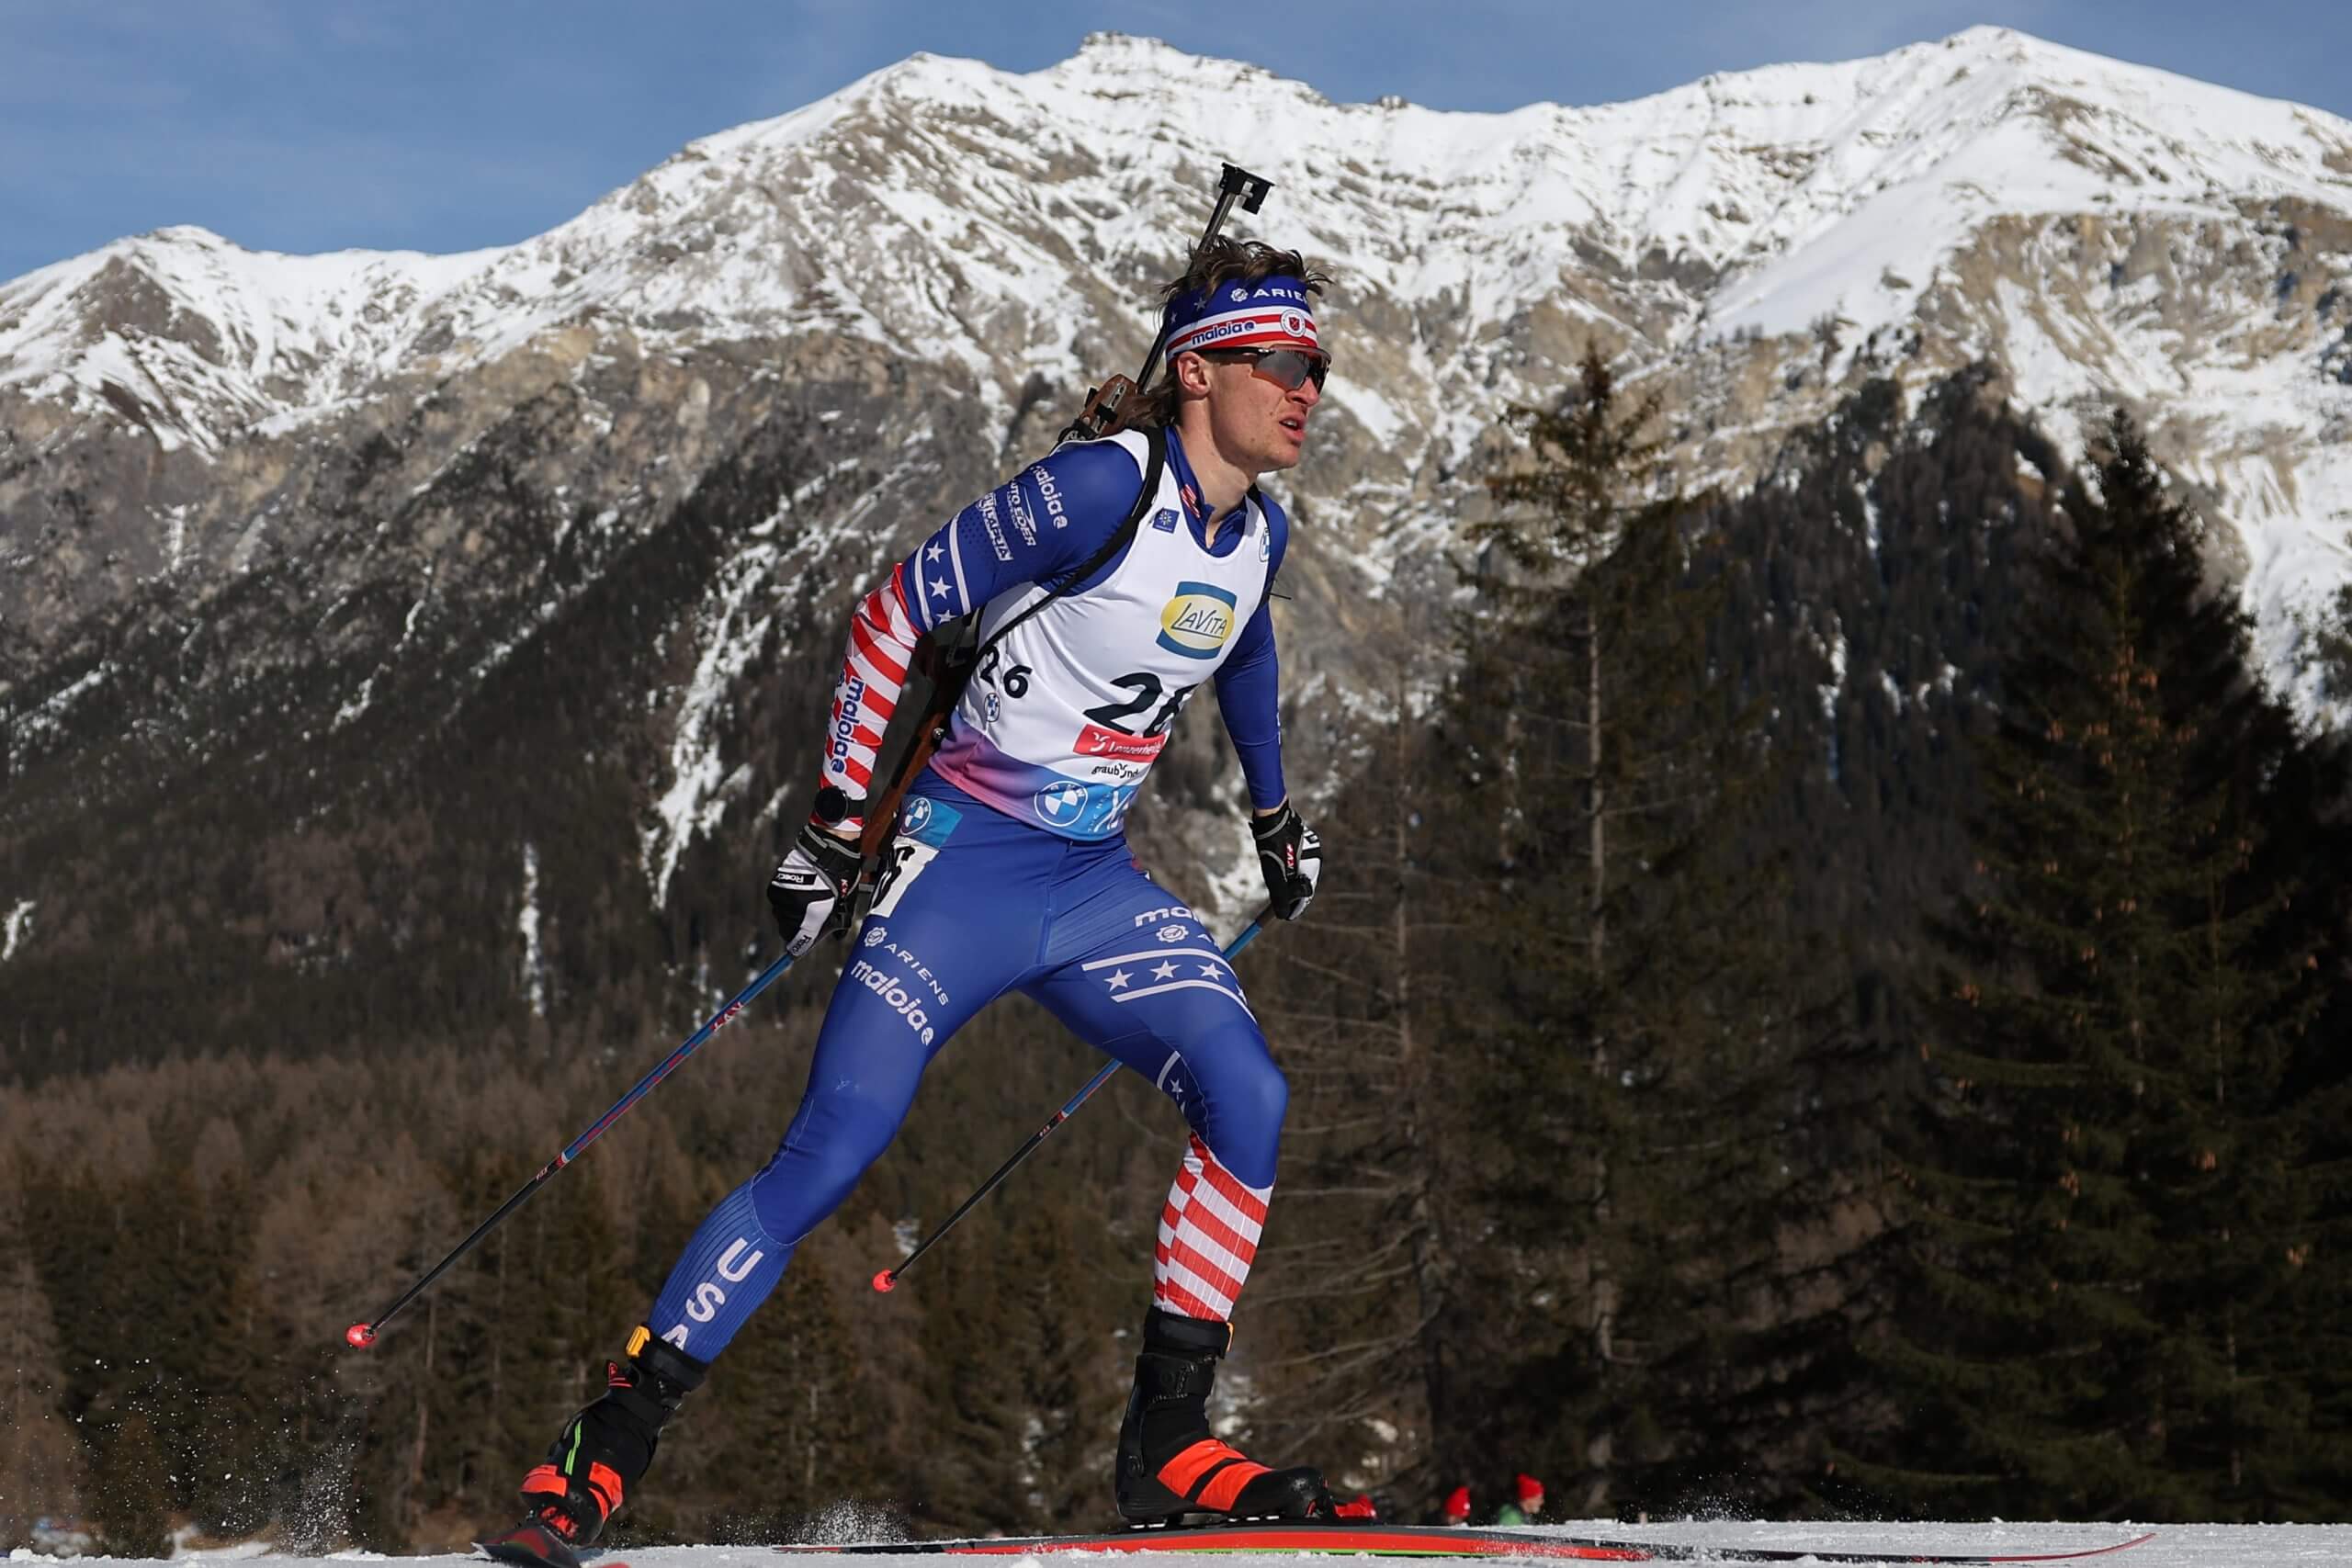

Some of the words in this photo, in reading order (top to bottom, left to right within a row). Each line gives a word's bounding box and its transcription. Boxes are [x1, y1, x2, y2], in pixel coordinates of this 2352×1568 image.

[1252, 288, 1307, 304] ARIE
[1192, 321, 1243, 345] maloja
[1013, 506, 1037, 546] EDER
[979, 644, 1033, 699] 26
[833, 677, 865, 757] maloja
[850, 960, 928, 1031] maloja
[884, 942, 949, 1006] ARIENS
[661, 1236, 764, 1351] USA
